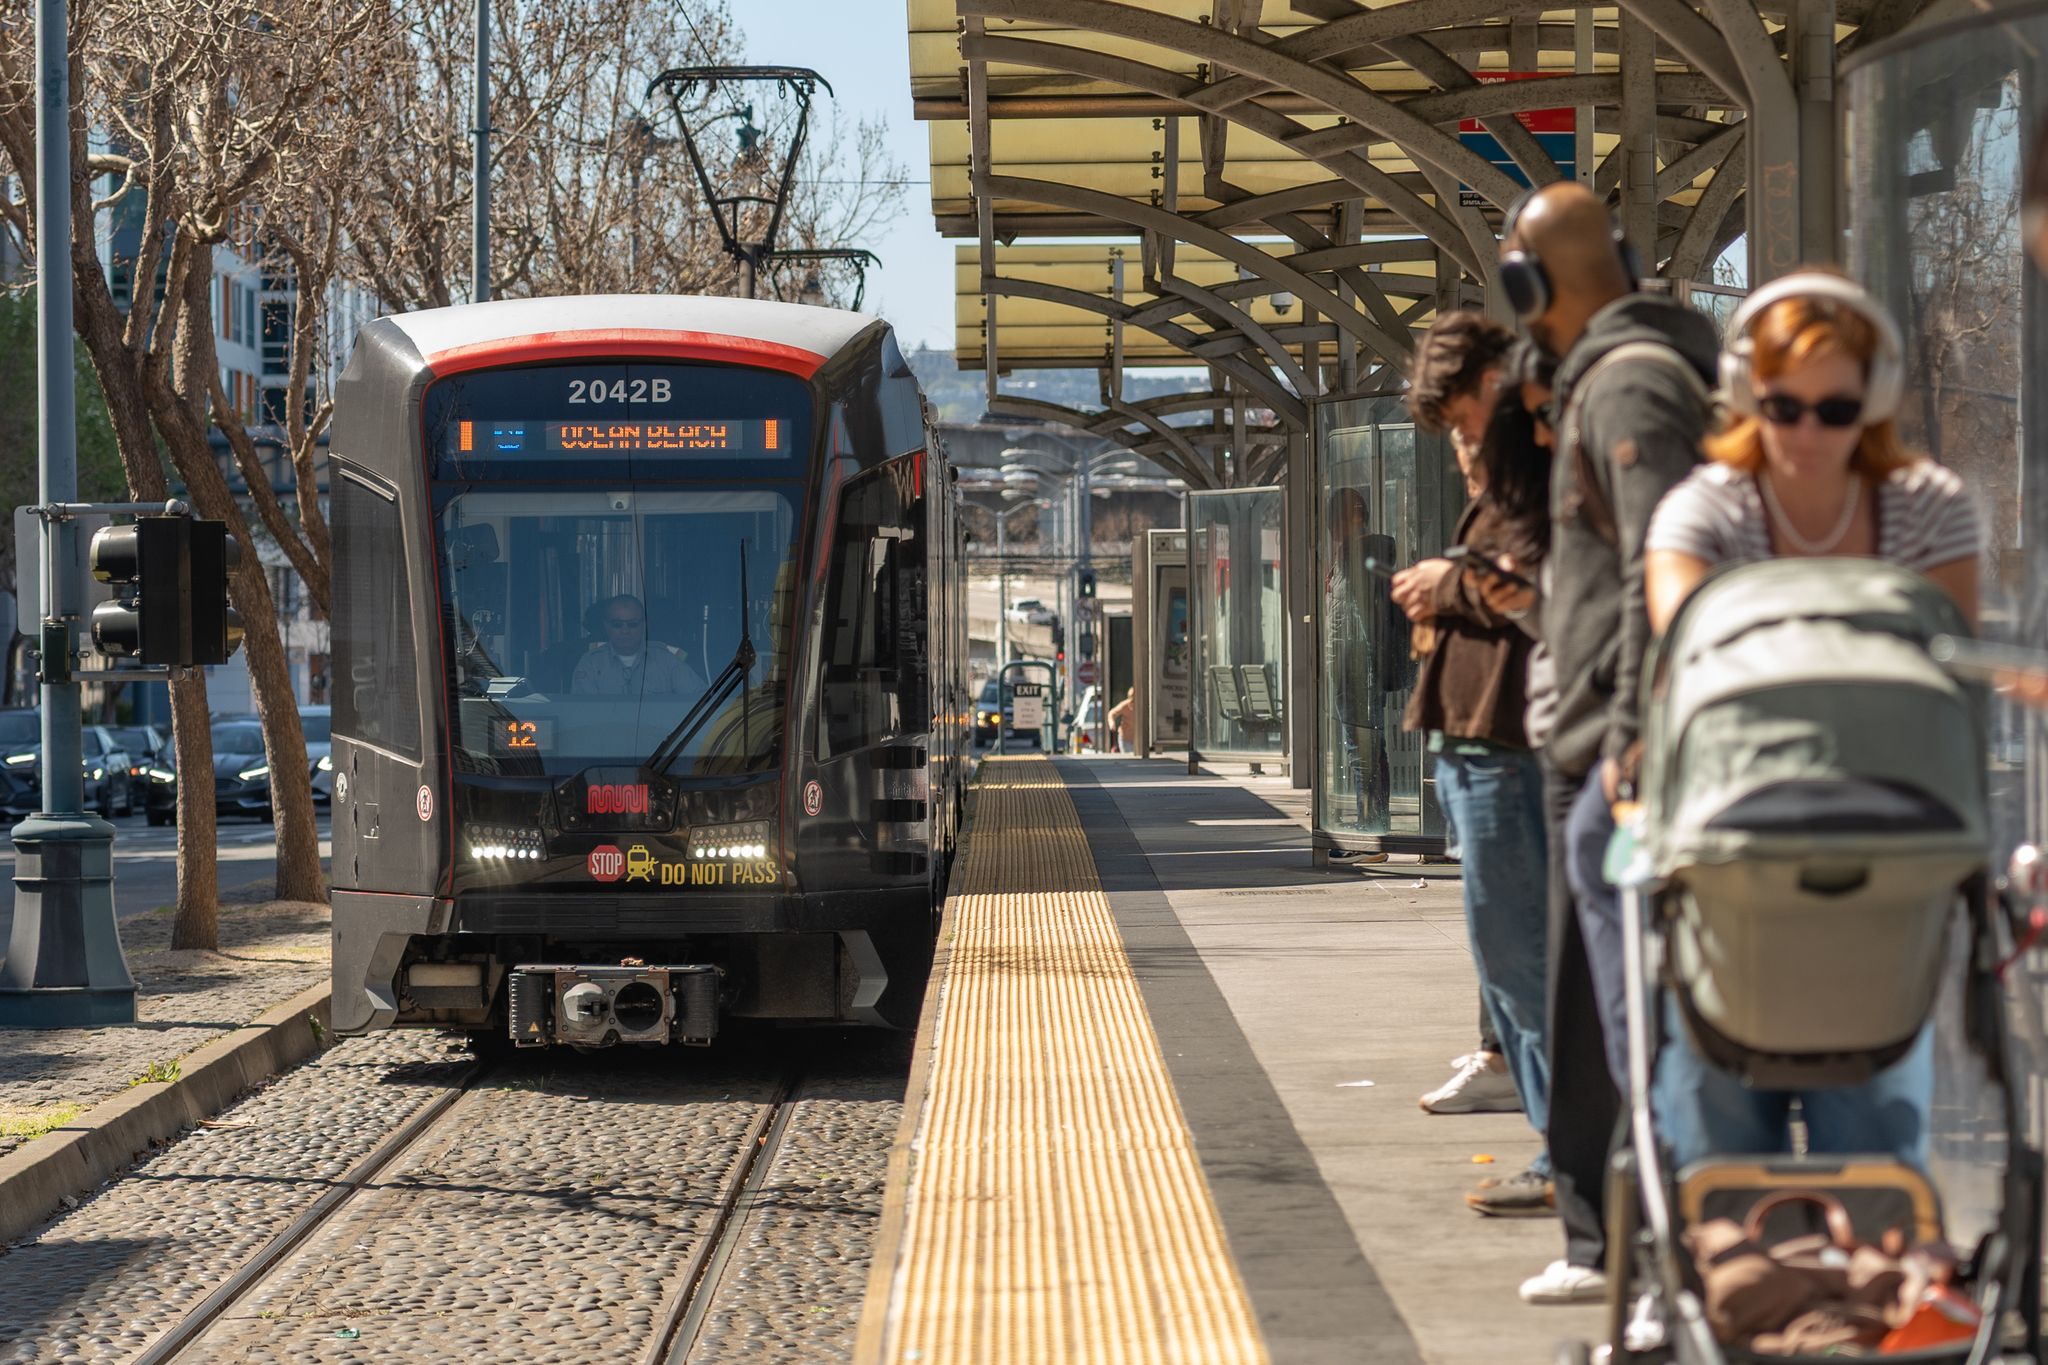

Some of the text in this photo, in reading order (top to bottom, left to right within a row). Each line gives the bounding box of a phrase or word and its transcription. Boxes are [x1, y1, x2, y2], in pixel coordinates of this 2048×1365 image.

[568, 378, 672, 404] 2042B
[561, 426, 727, 449] OCEAN BEACH
[1015, 685, 1039, 696] EXIT
[507, 721, 537, 747] 12
[591, 852, 623, 875] STOP
[661, 861, 777, 885] DO NOT PASS
